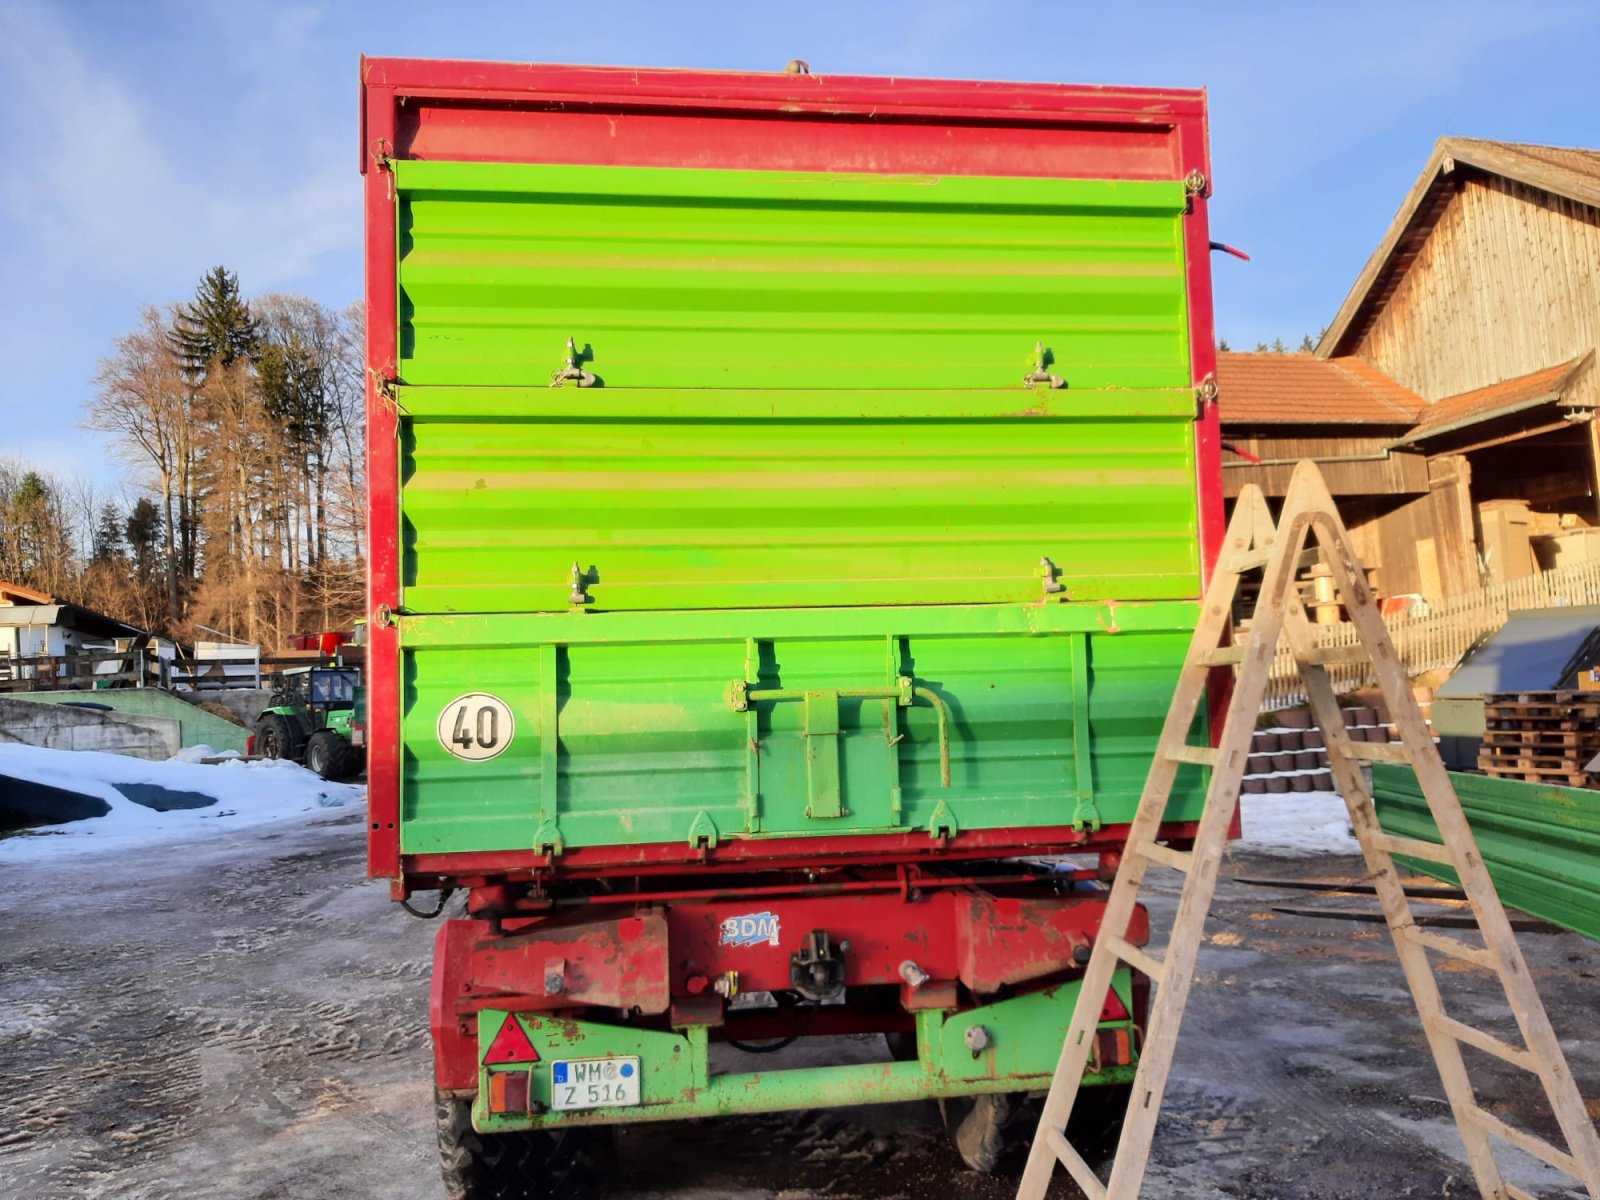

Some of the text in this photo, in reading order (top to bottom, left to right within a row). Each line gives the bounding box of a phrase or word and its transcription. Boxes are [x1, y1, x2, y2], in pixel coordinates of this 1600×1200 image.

[452, 705, 499, 749] 40
[574, 1063, 601, 1083] WM
[564, 1084, 626, 1105] Z 516
